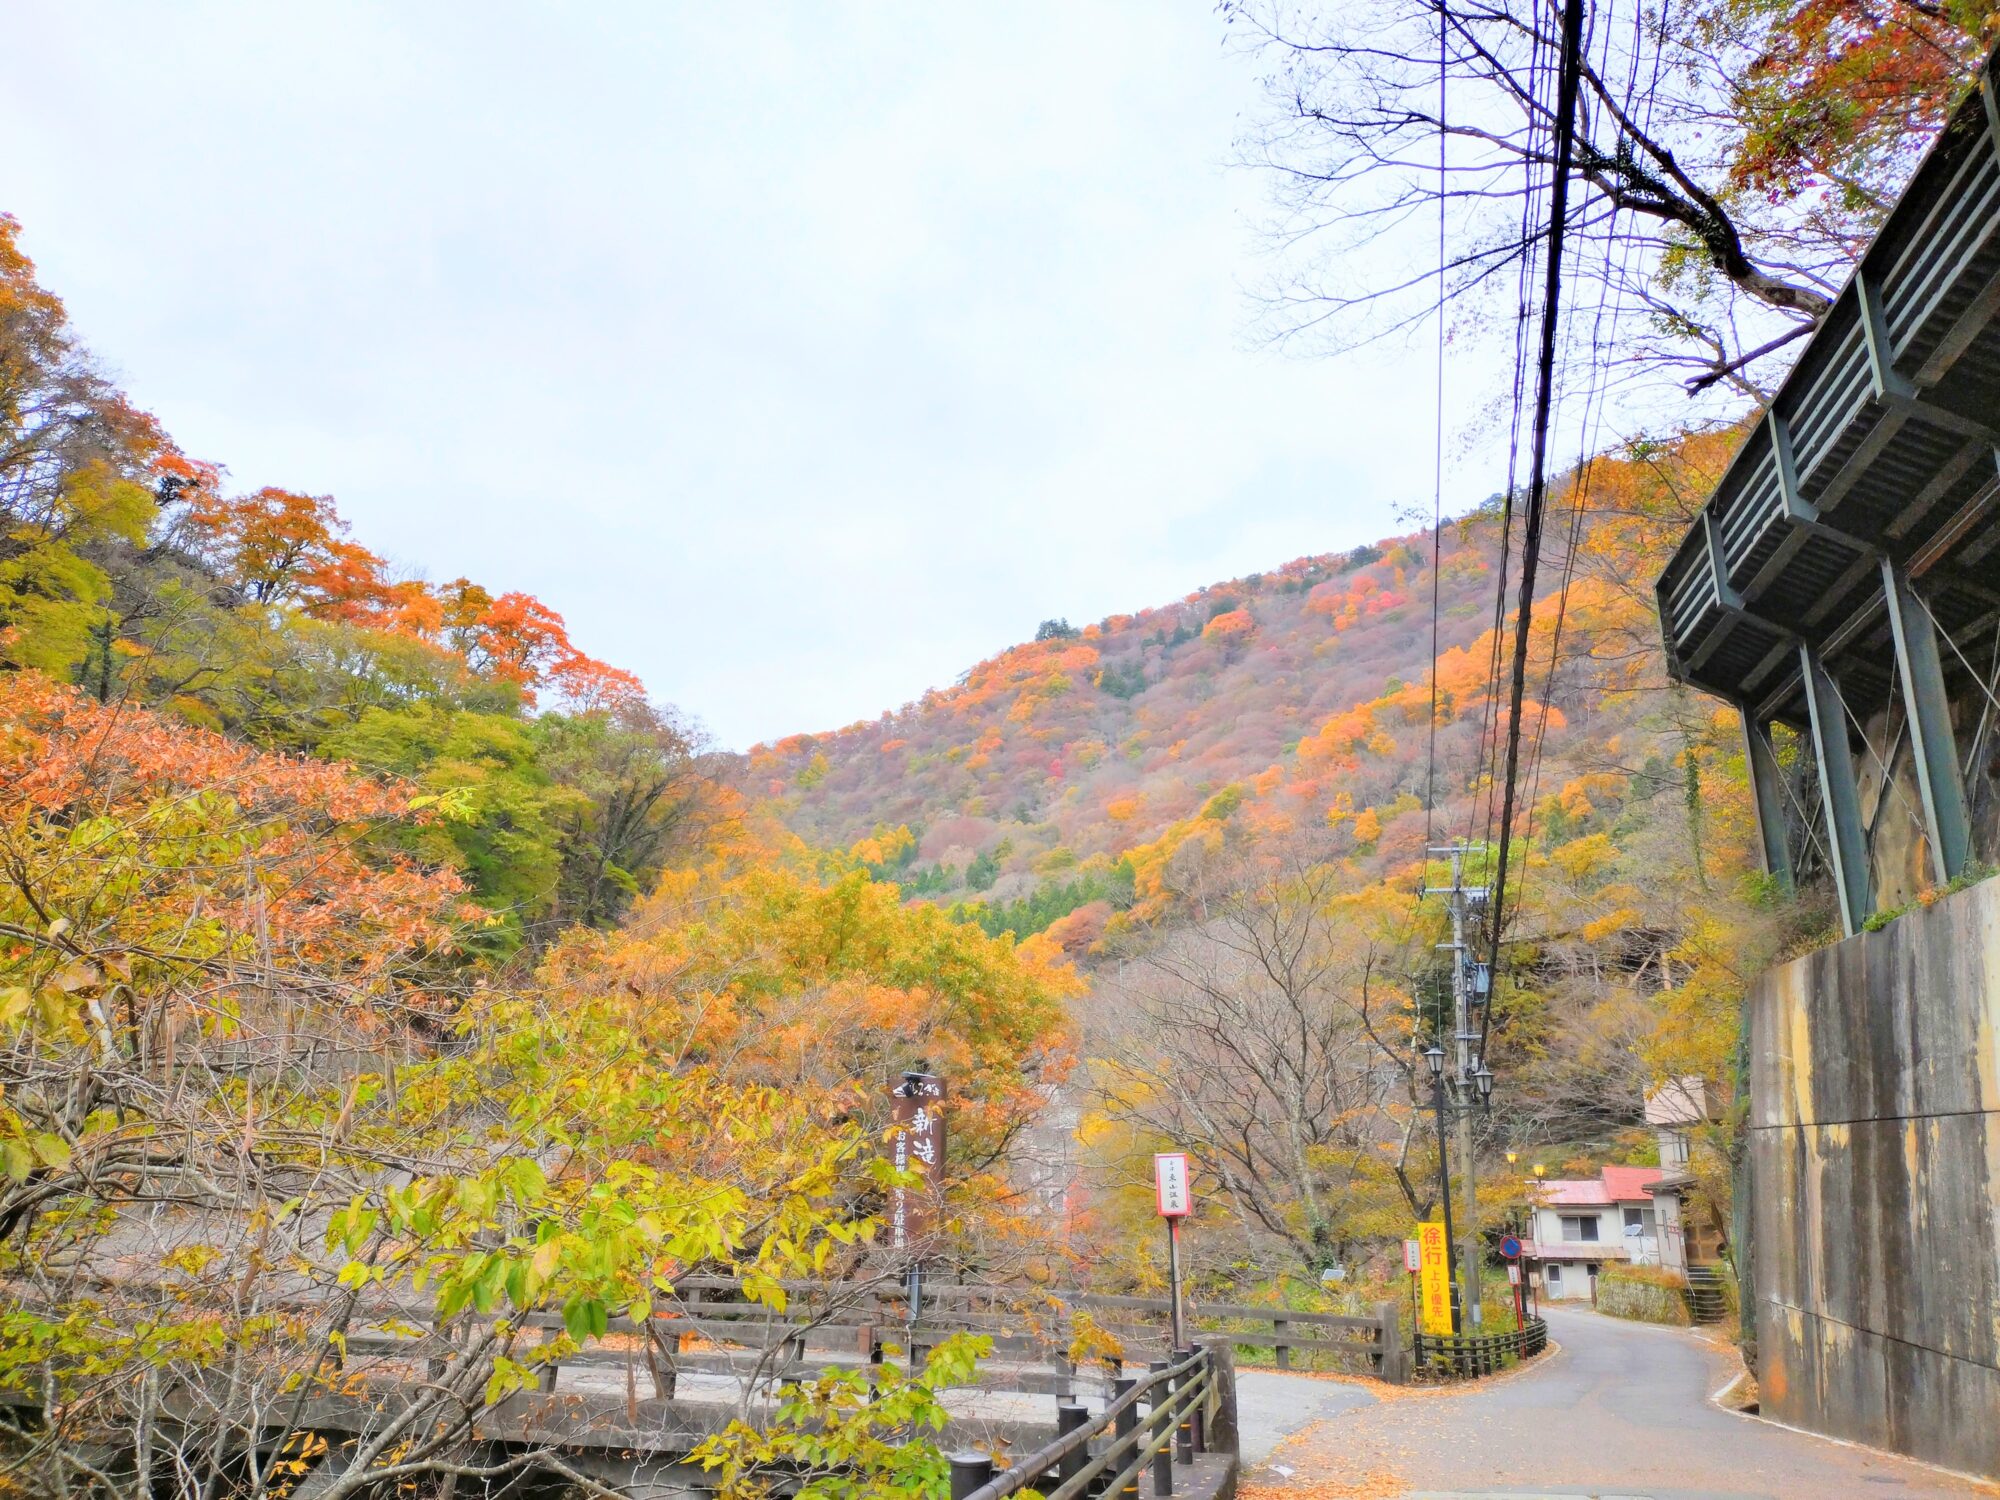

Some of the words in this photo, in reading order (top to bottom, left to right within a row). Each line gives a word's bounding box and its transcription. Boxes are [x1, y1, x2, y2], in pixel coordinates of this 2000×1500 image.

[1424, 1227, 1441, 1265] 徐行
[1430, 1270, 1443, 1317] 上り優先
